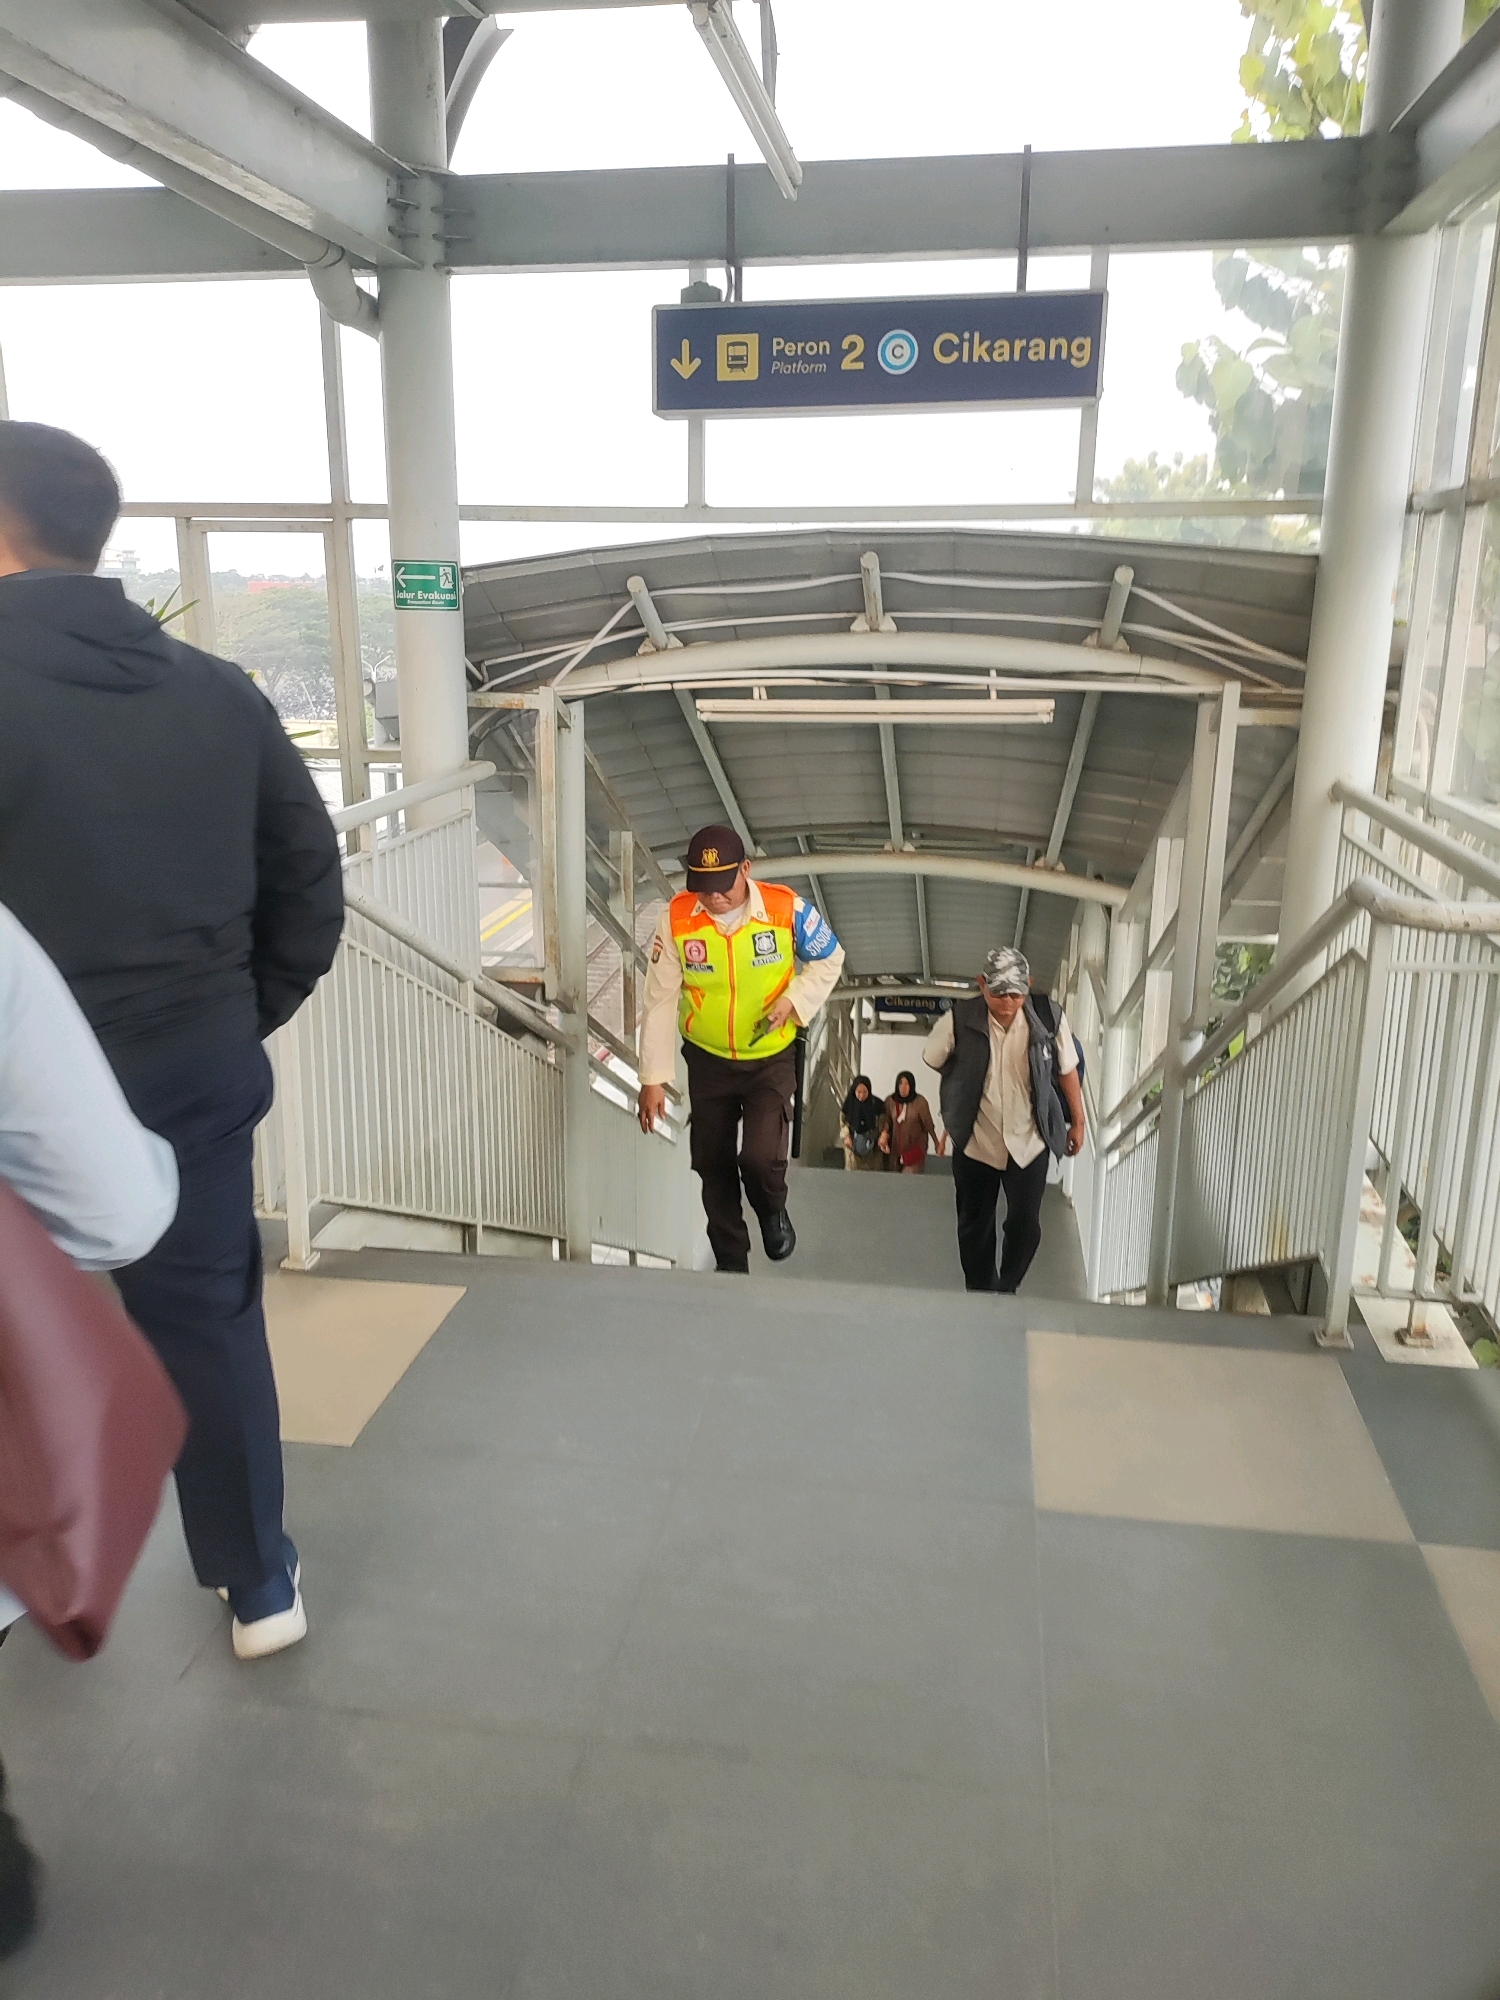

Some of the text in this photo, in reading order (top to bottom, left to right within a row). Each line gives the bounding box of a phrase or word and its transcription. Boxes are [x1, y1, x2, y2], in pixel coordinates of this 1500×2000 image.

[772, 336, 830, 356] Peron
[840, 334, 865, 370] 2
[933, 330, 1092, 368] Cikarang
[770, 360, 828, 375] Platform
[396, 590, 456, 600] Jalur Evakuasi
[884, 996, 936, 1011] Cikarang
